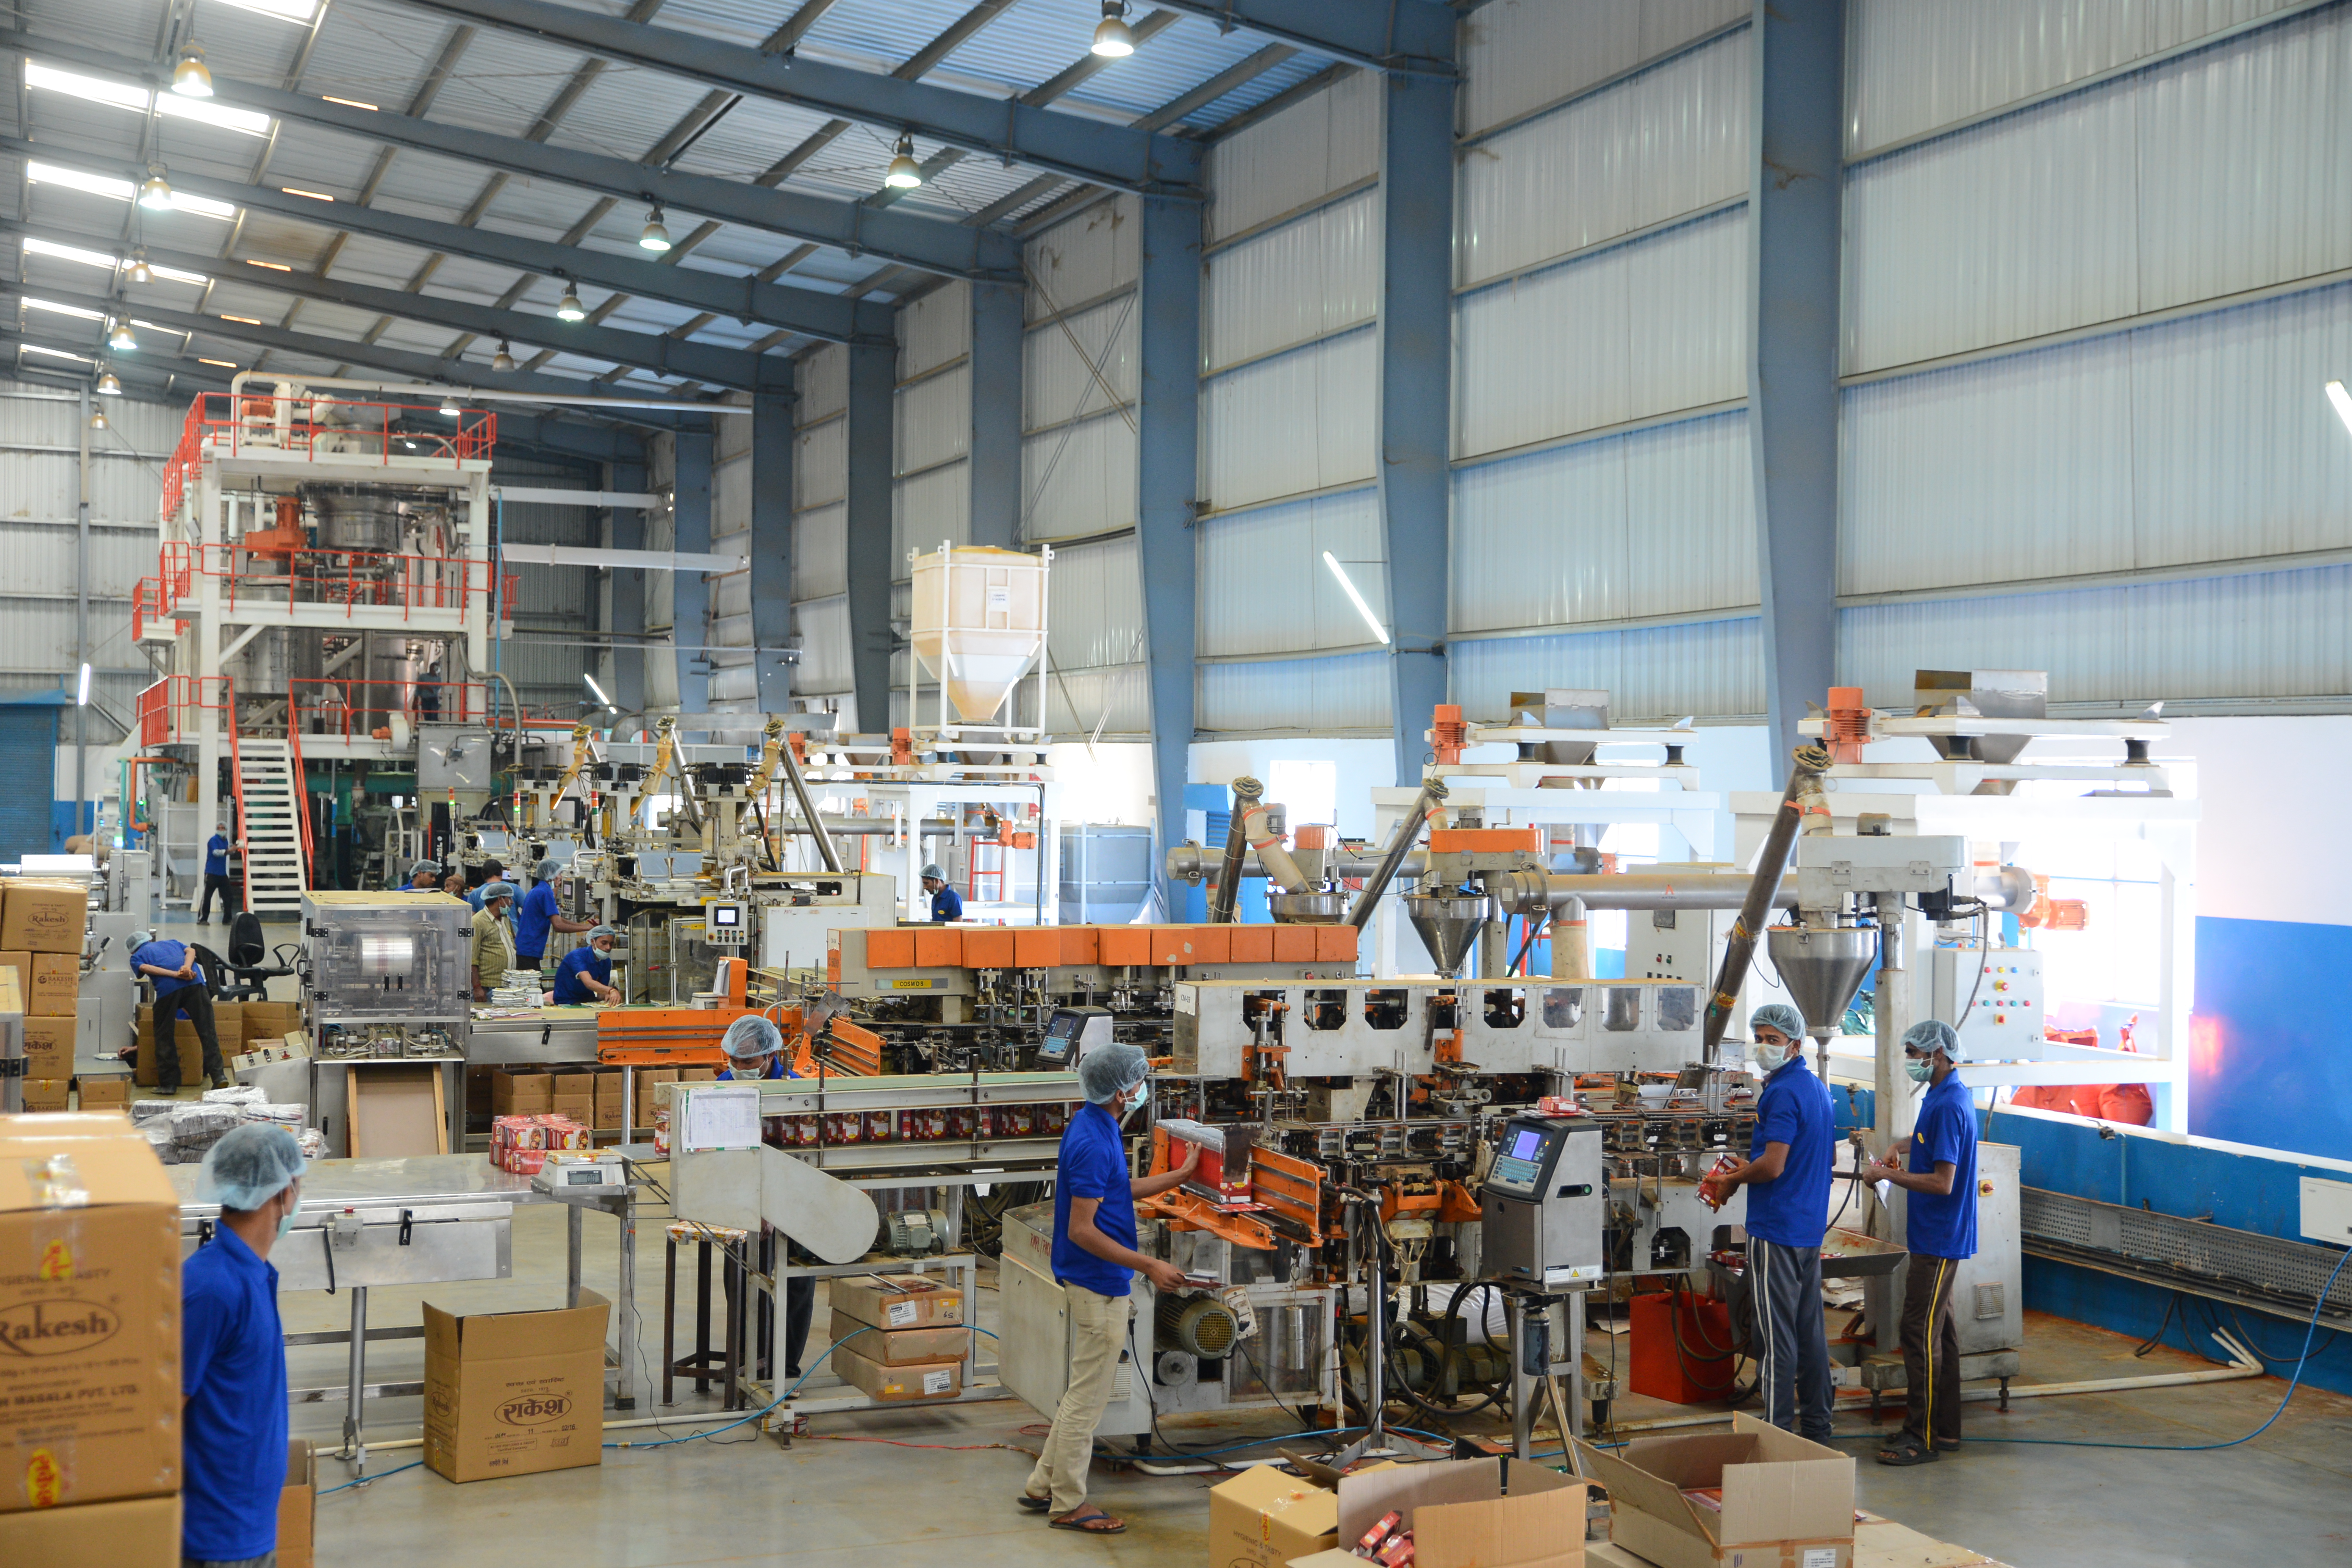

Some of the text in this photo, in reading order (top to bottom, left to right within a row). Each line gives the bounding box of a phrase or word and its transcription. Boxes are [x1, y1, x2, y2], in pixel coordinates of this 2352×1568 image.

[32, 912, 65, 926] Rakesh
[1181, 994, 1191, 1003] CM-03
[503, 1399, 565, 1426] राकेश
[1233, 1530, 1258, 1547] HYGIENIC
[1265, 1545, 1282, 1558] TASTY
